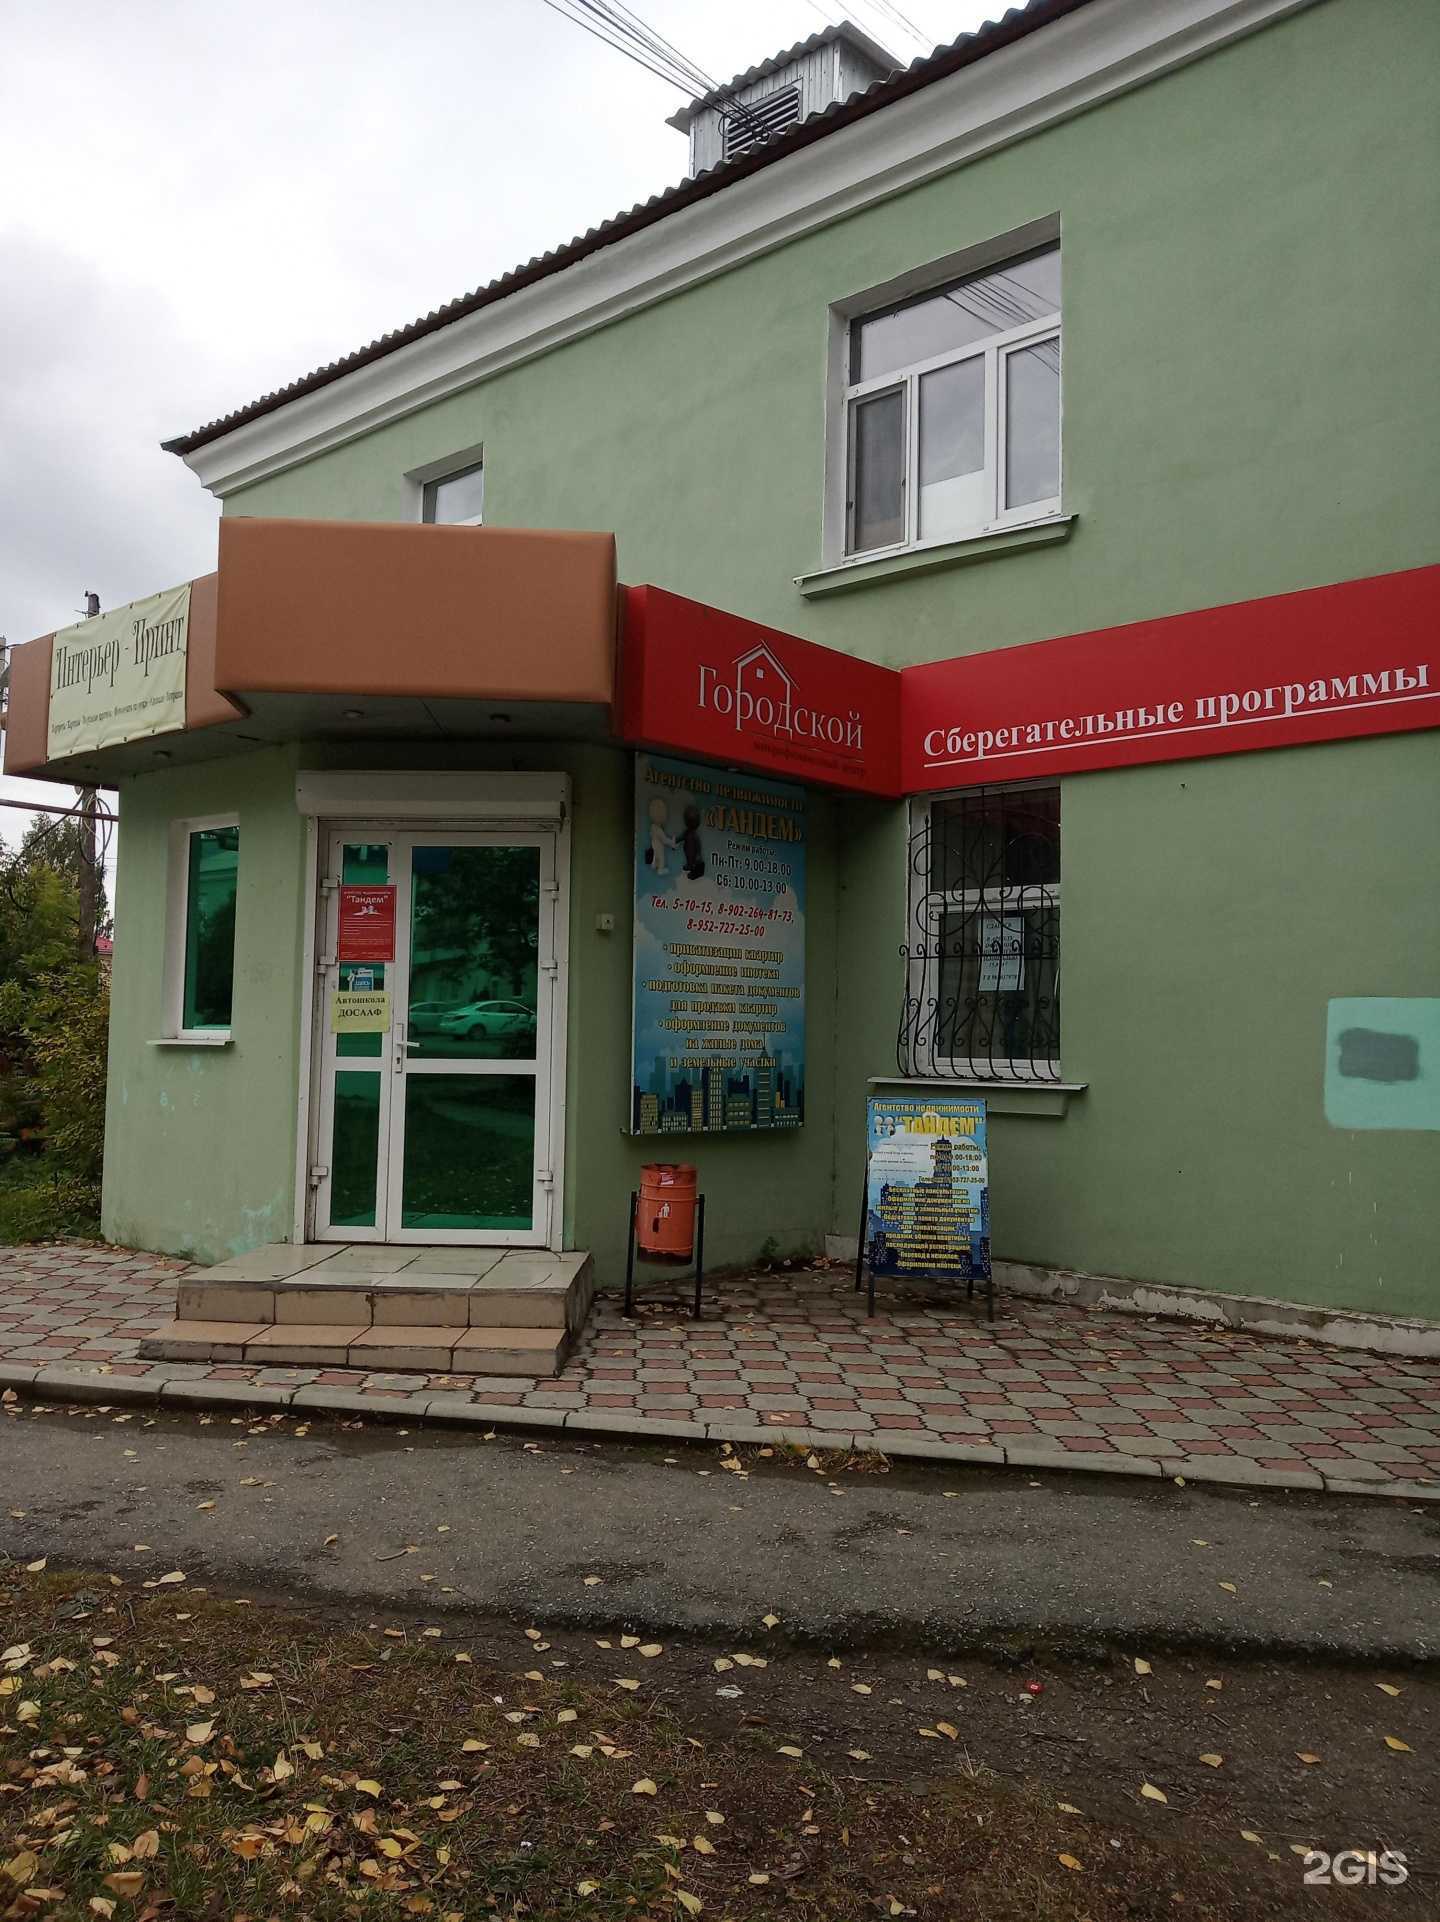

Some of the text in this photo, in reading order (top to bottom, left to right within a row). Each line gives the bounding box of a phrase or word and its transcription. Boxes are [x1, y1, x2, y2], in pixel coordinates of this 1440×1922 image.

[56, 638, 121, 695] Интерьер
[133, 615, 185, 677] Принт
[697, 664, 863, 750] Городской
[923, 697, 1184, 760] Сберегательные
[1195, 664, 1430, 726] программы
[716, 874, 733, 889] Сб:
[651, 895, 669, 910] Тел.
[672, 898, 714, 915] 5-10-15,
[686, 918, 766, 938] 8-952-727-25-00
[648, 979, 708, 994] подготовка
[747, 985, 801, 999] документов
[336, 996, 385, 1005] Автошкола
[338, 1008, 382, 1018] ДОСААФ
[664, 1016, 787, 1034] оформление документов
